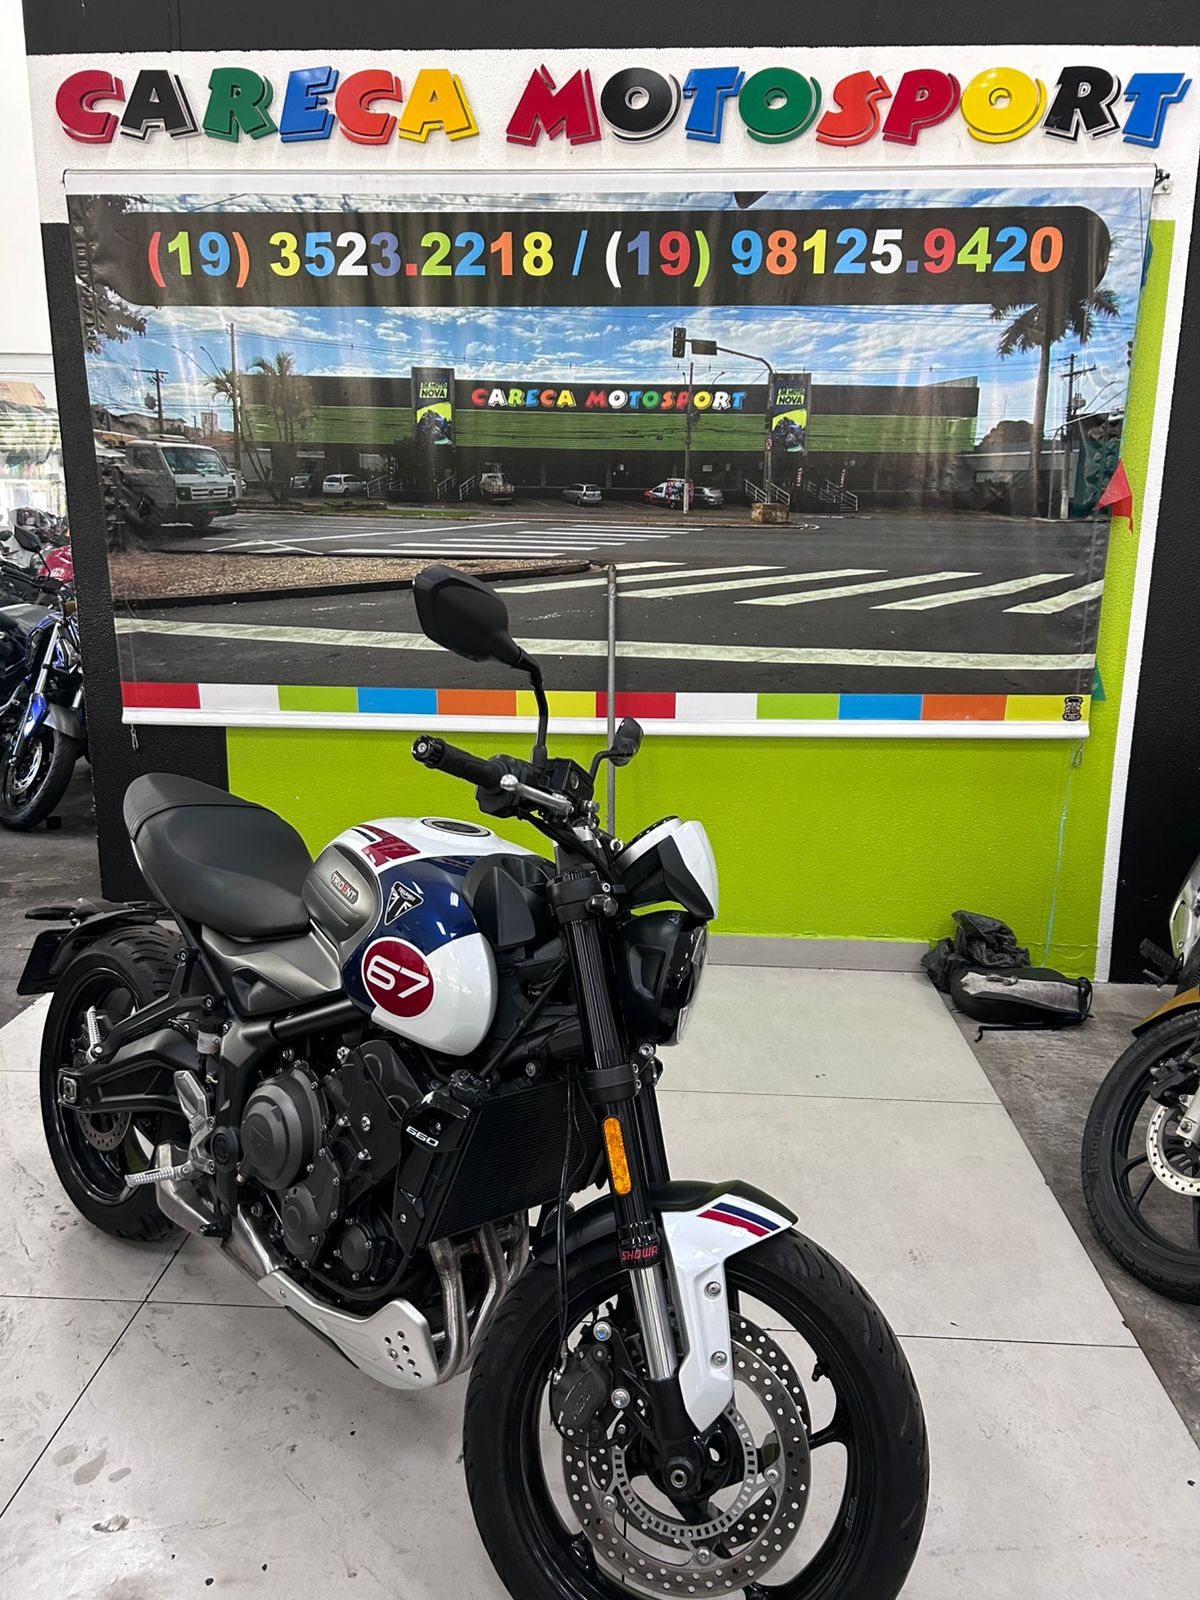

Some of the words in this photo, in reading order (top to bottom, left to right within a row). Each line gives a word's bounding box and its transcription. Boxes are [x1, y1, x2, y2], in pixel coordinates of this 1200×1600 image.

[56, 66, 480, 145] CARECA
[505, 64, 1193, 148] MOTOSPORT
[149, 230, 250, 287] (19)
[269, 229, 554, 278] 3523.2218
[572, 229, 588, 276] /
[605, 229, 711, 288] (19)
[731, 226, 1064, 276] 98125.9420
[420, 389, 446, 398] NOVA
[471, 388, 577, 408] CARECA
[585, 389, 747, 410] MOTOSPORT
[778, 396, 803, 404] NOVA
[331, 872, 357, 900] TRIDENT
[366, 954, 430, 999] 67
[406, 1126, 439, 1147] 660
[621, 1245, 658, 1260] SHOWA
